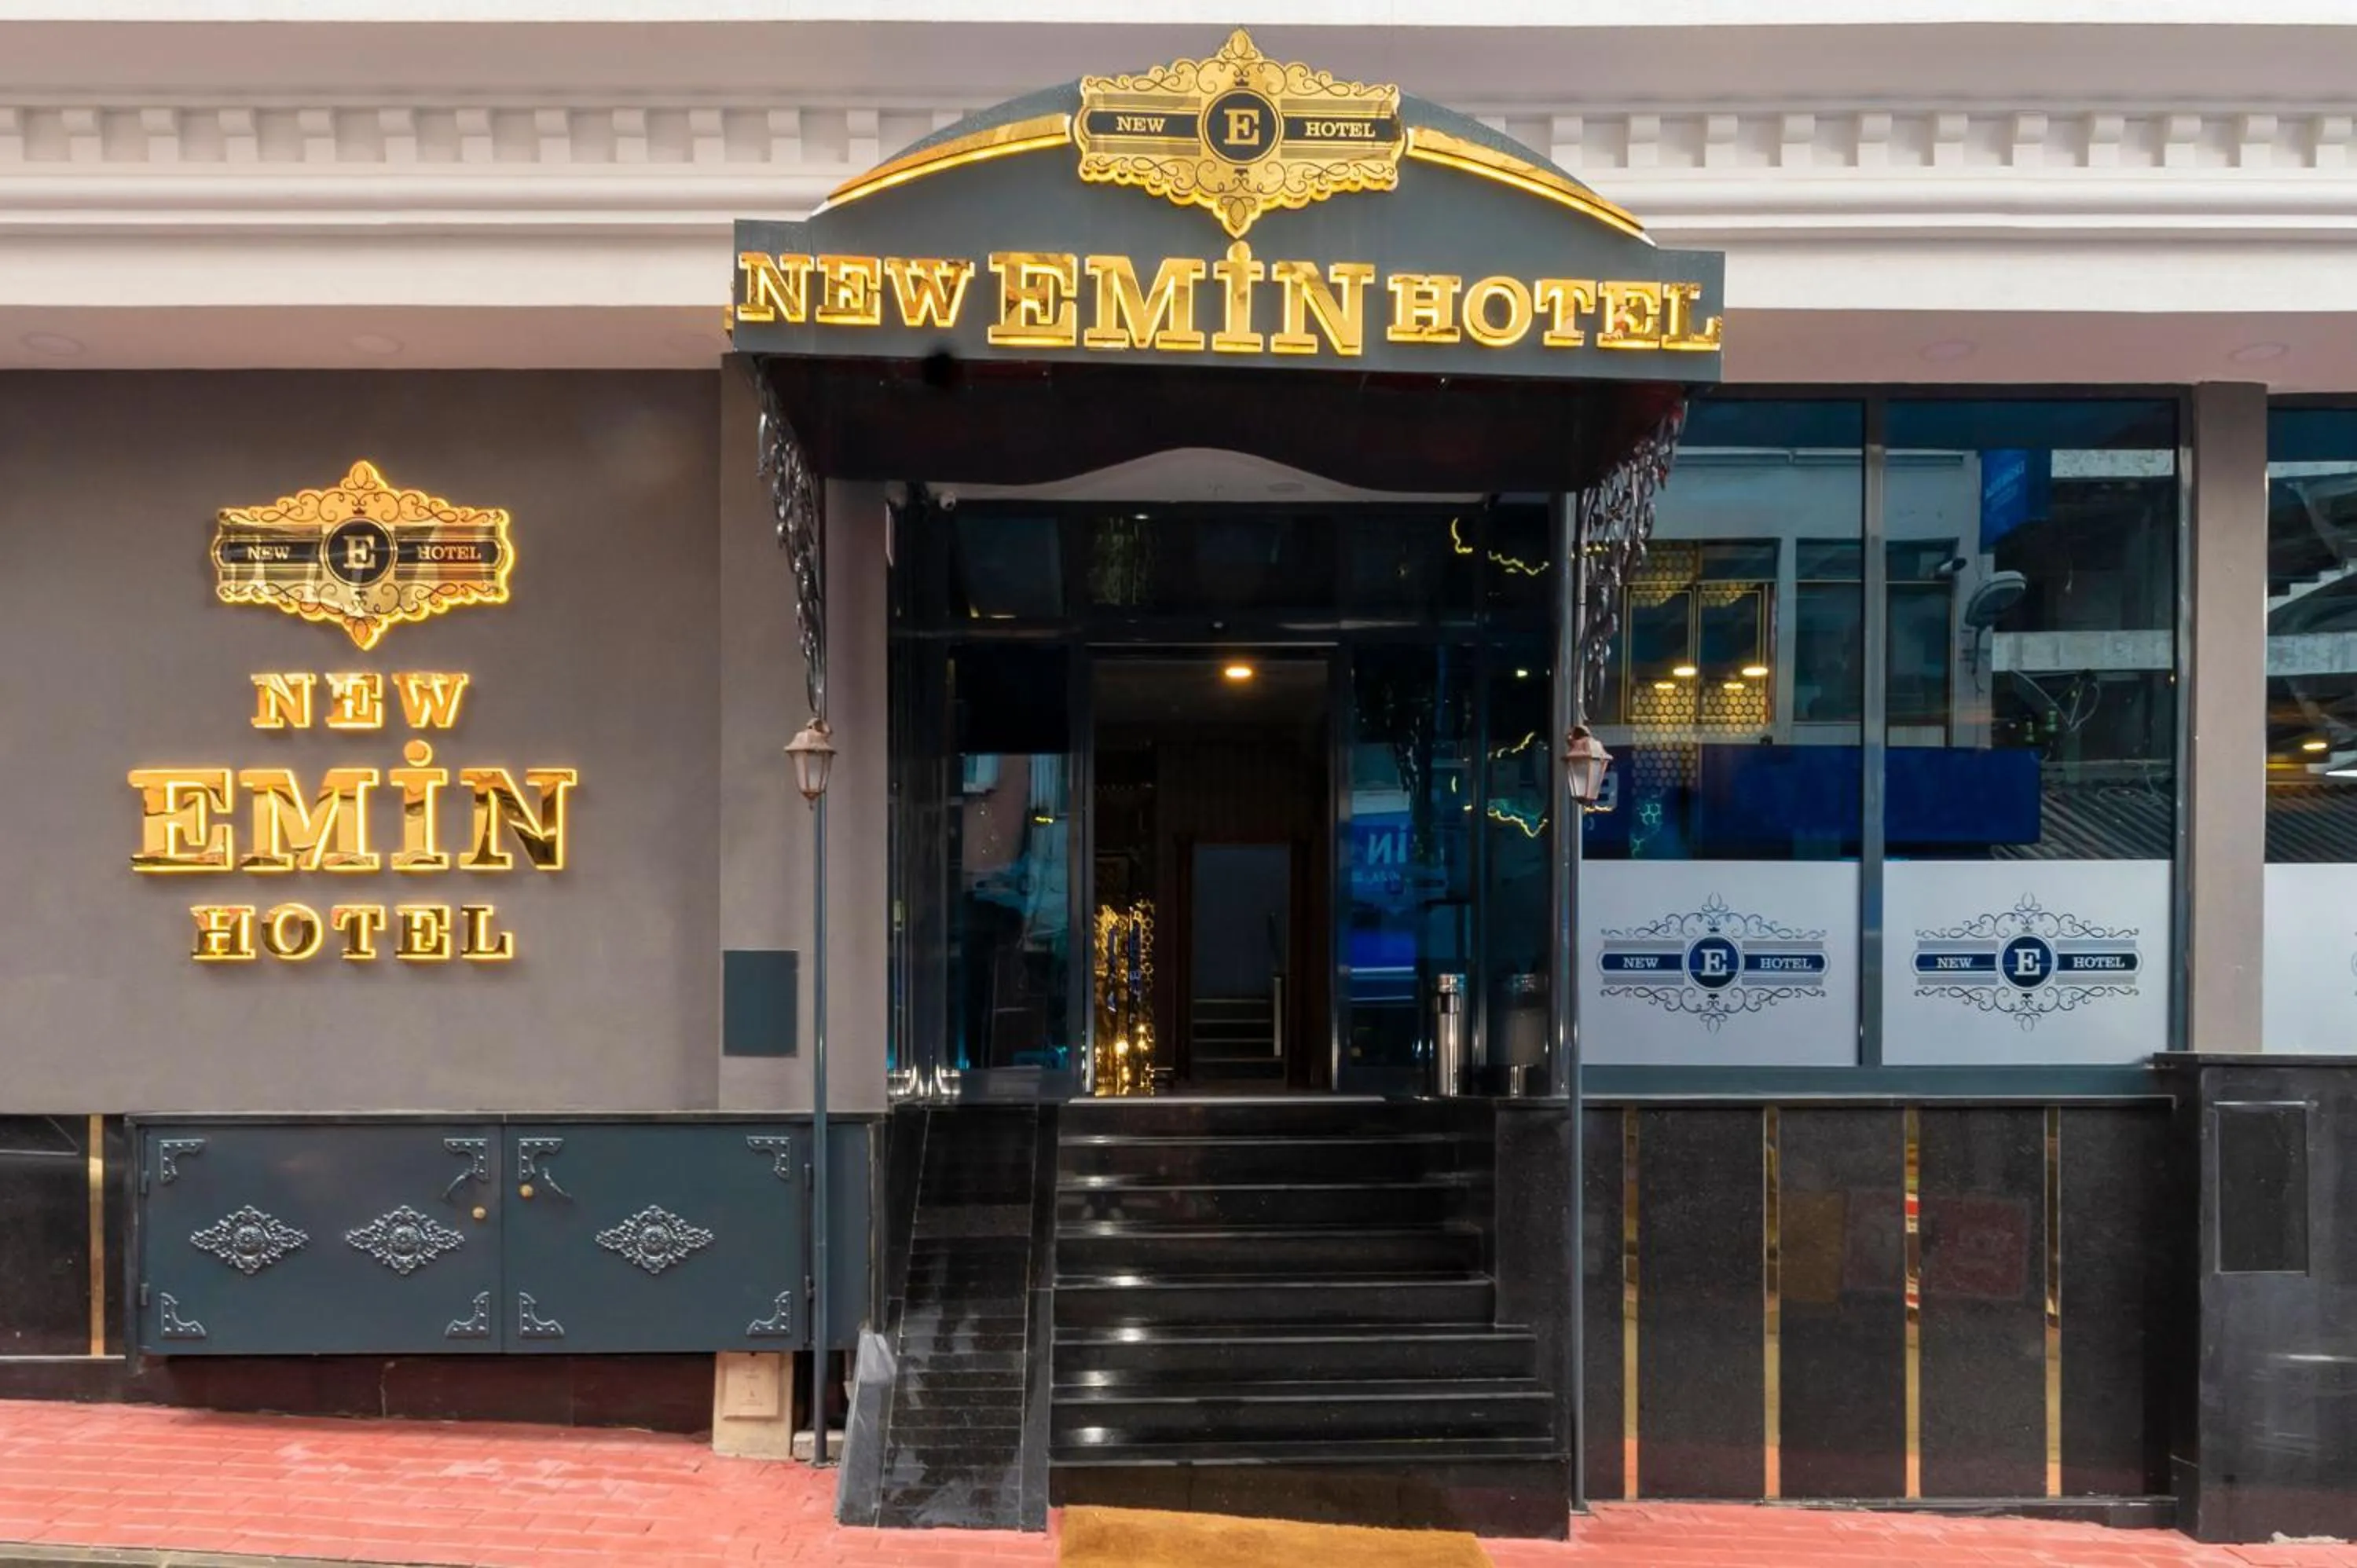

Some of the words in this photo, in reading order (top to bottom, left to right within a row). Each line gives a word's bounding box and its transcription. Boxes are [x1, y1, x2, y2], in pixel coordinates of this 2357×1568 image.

[1116, 115, 1165, 133] NEW
[1223, 108, 1260, 145] E
[1305, 121, 1376, 139] HOTEL
[738, 251, 976, 328] NEW
[988, 239, 1375, 356] EMİN
[1387, 275, 1721, 352] HOTEL
[247, 545, 291, 560] NEW
[343, 535, 377, 570] E
[417, 545, 482, 560] HOTEL
[250, 672, 469, 729] NEW
[128, 739, 578, 872] EMİN
[189, 902, 514, 960] HOTEL
[1622, 957, 1659, 969] NEW
[1700, 949, 1728, 976] E
[1760, 957, 1813, 969] HOTEL
[1936, 957, 1973, 969] NEW
[2014, 948, 2041, 976] E
[2073, 956, 2125, 969] HOTEL
